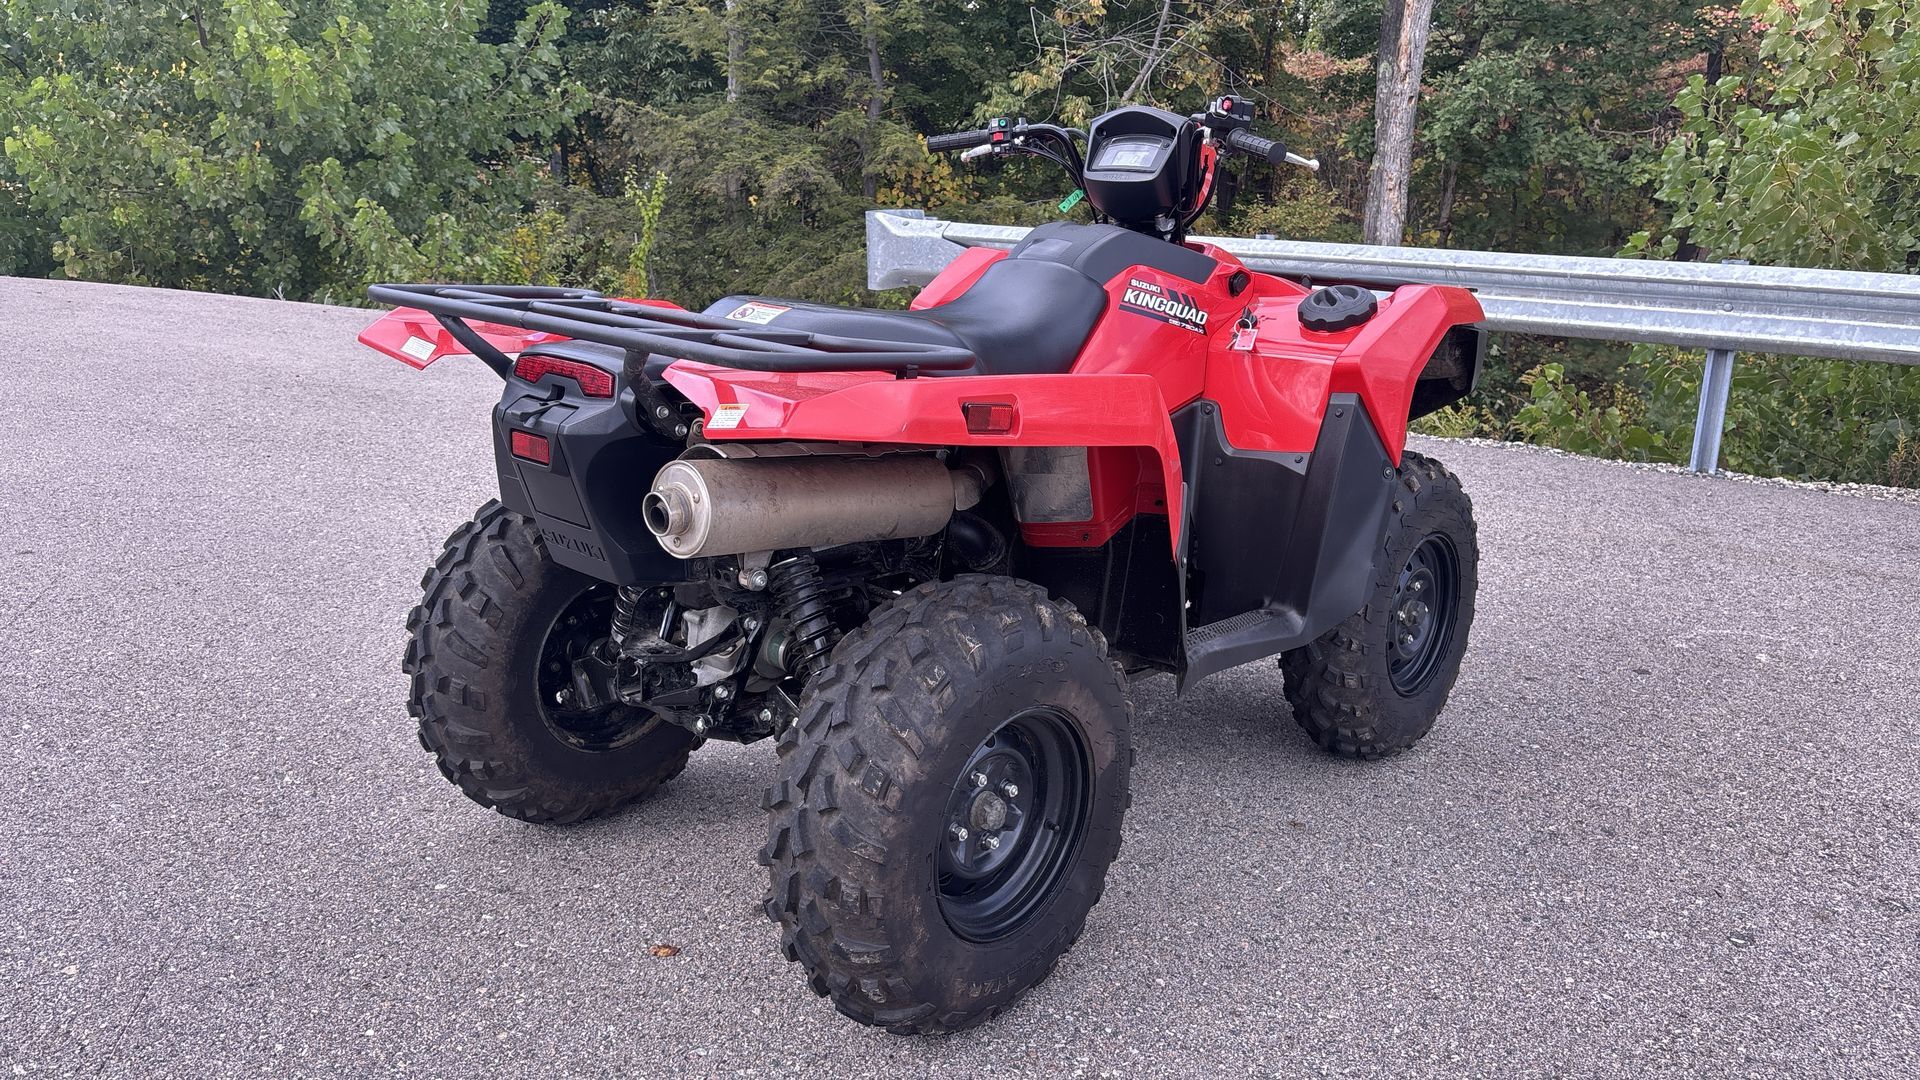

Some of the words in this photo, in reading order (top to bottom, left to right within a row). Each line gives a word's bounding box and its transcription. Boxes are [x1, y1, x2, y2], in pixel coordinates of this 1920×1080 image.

[1130, 279, 1161, 293] SUZUKI
[1123, 288, 1209, 326] KINGQUAD
[541, 528, 607, 562] SUZUKI
